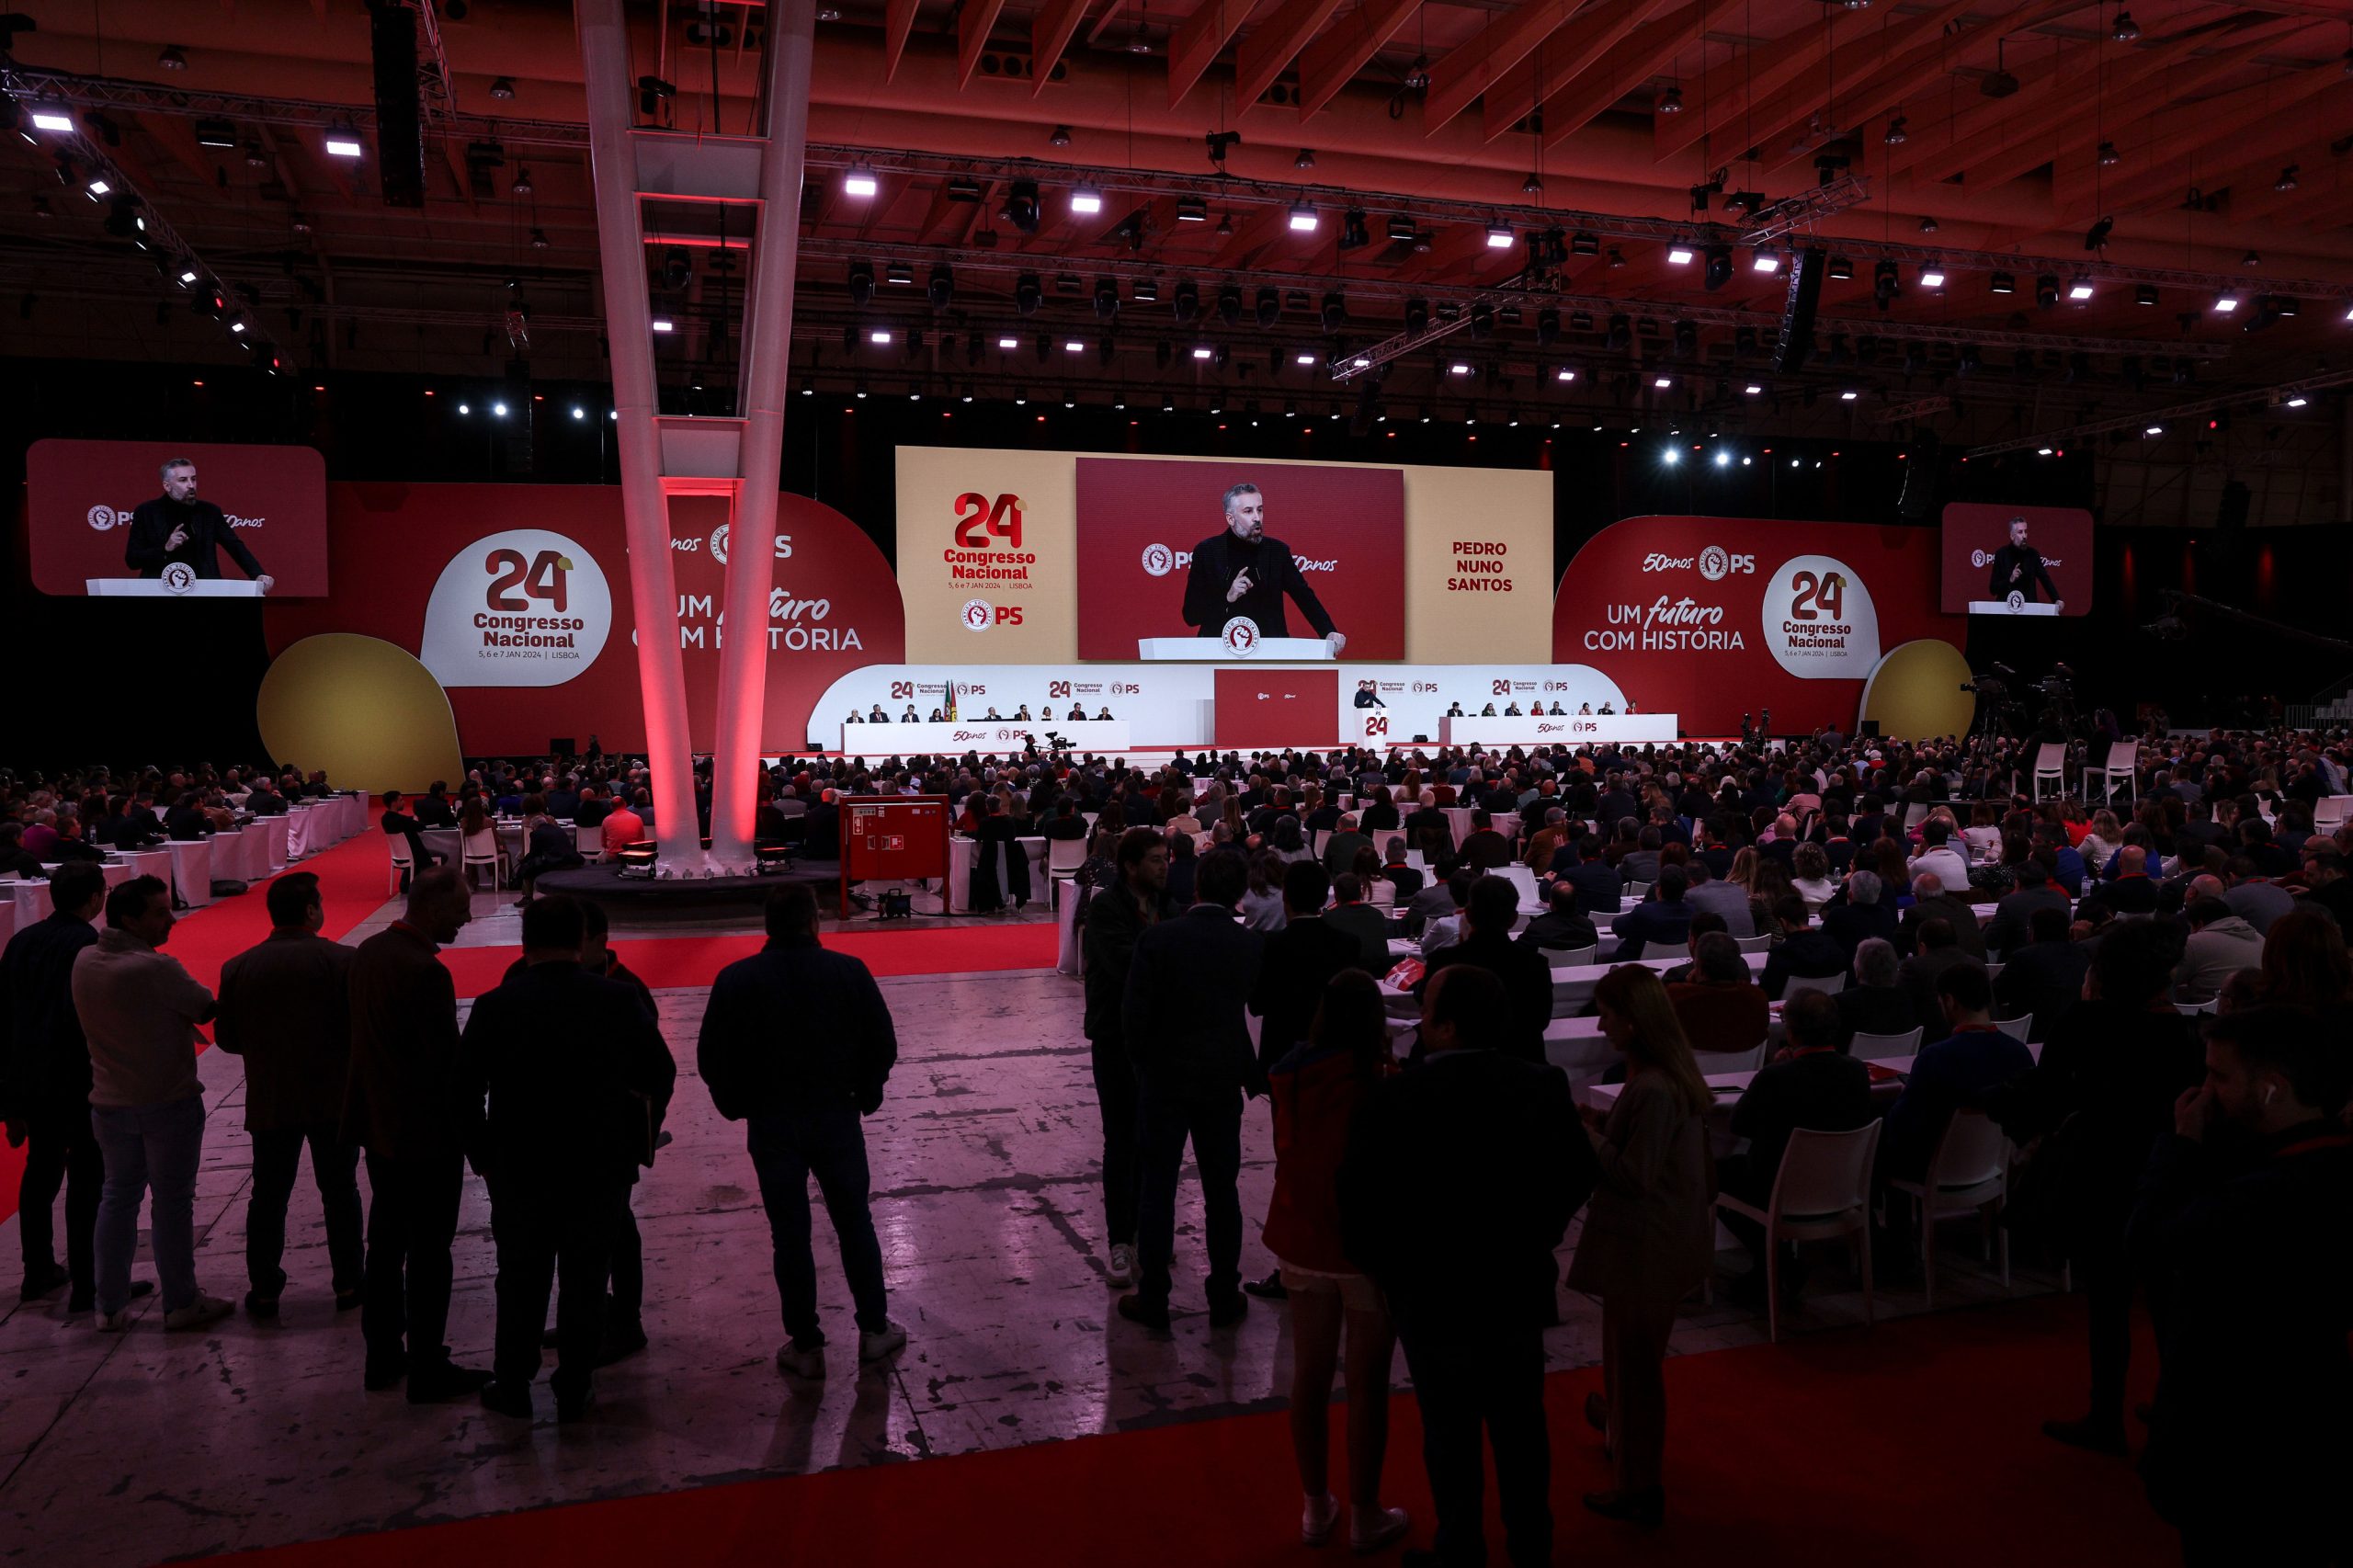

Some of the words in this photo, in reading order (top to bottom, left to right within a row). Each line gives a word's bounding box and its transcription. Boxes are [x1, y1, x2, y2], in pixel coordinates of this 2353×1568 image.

[223, 514, 265, 528] 0anos
[954, 493, 1022, 549] 24
[1453, 542, 1506, 555] PEDRO
[944, 549, 1036, 566] Congresso
[1291, 555, 1338, 574] 0anos
[1730, 554, 1756, 574] PS
[952, 565, 1028, 579] Nacional
[1457, 560, 1504, 574] NUNO
[485, 548, 567, 613] 24
[1448, 578, 1513, 592] SANTOS
[1791, 571, 1843, 621] 24
[995, 607, 1023, 625] PS
[1608, 605, 1641, 624] UM
[1643, 595, 1723, 631] futuro
[473, 613, 585, 632] Congresso
[1782, 620, 1851, 637] Congresso
[483, 631, 574, 648] Nacional
[1584, 631, 1634, 651] COM
[1643, 626, 1745, 650] HISTÓRIA
[1789, 635, 1845, 649] Nacional
[891, 681, 914, 699] 24
[971, 685, 985, 695] PS
[1050, 680, 1071, 699] 24
[1125, 684, 1140, 694] PS
[1426, 684, 1438, 692] PS
[1493, 679, 1510, 696] 24
[1556, 682, 1568, 691] PS
[1366, 716, 1388, 736] 24
[1585, 722, 1597, 732] PS
[1013, 730, 1028, 740] PS
